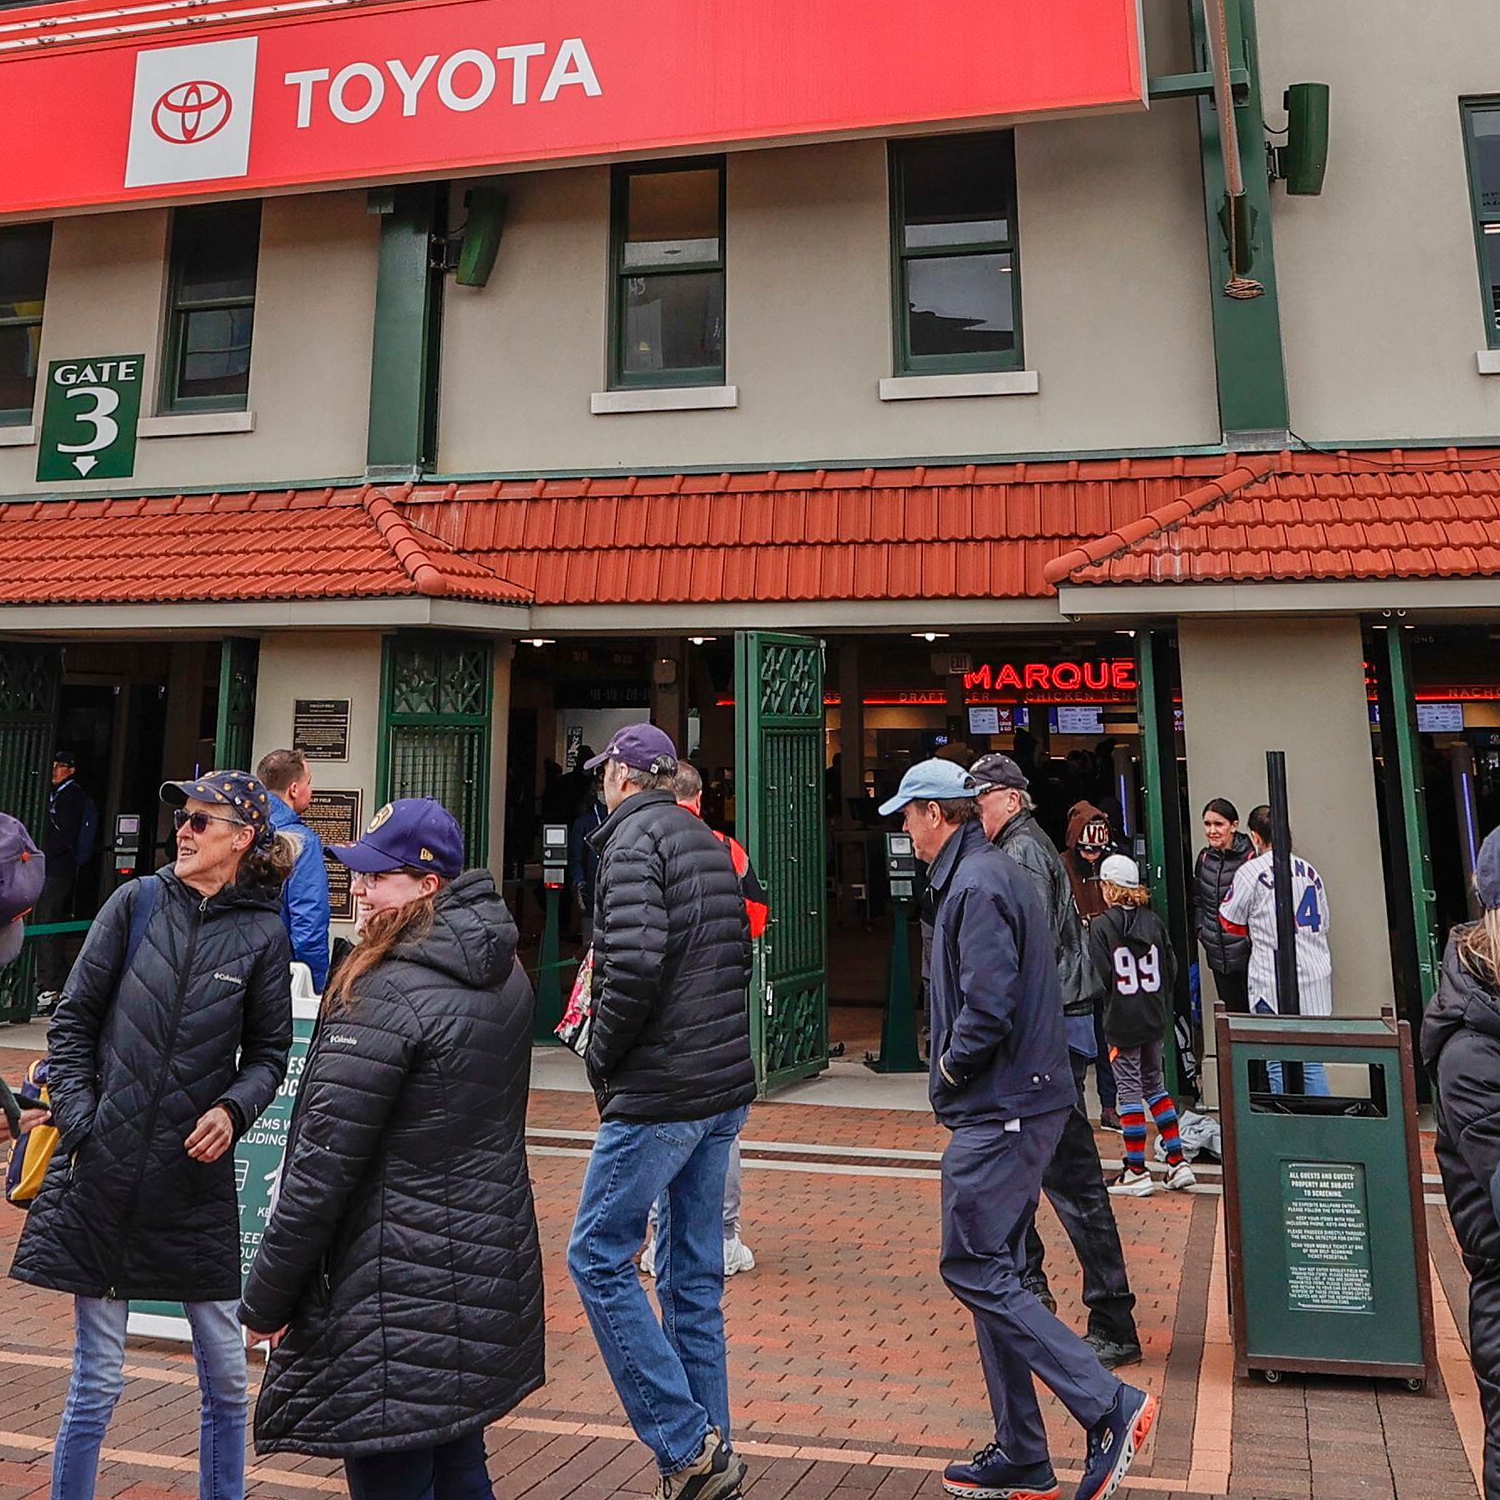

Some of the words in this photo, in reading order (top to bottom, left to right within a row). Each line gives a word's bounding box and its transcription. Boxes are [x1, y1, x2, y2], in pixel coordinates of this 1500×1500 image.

[284, 37, 603, 130] TOYOTA
[53, 360, 138, 385] GATE
[57, 386, 120, 453] 3
[899, 692, 945, 702] DRAFT
[1026, 691, 1094, 702] CHICKEN
[1112, 944, 1162, 995] 99
[253, 1117, 281, 1131] EMS
